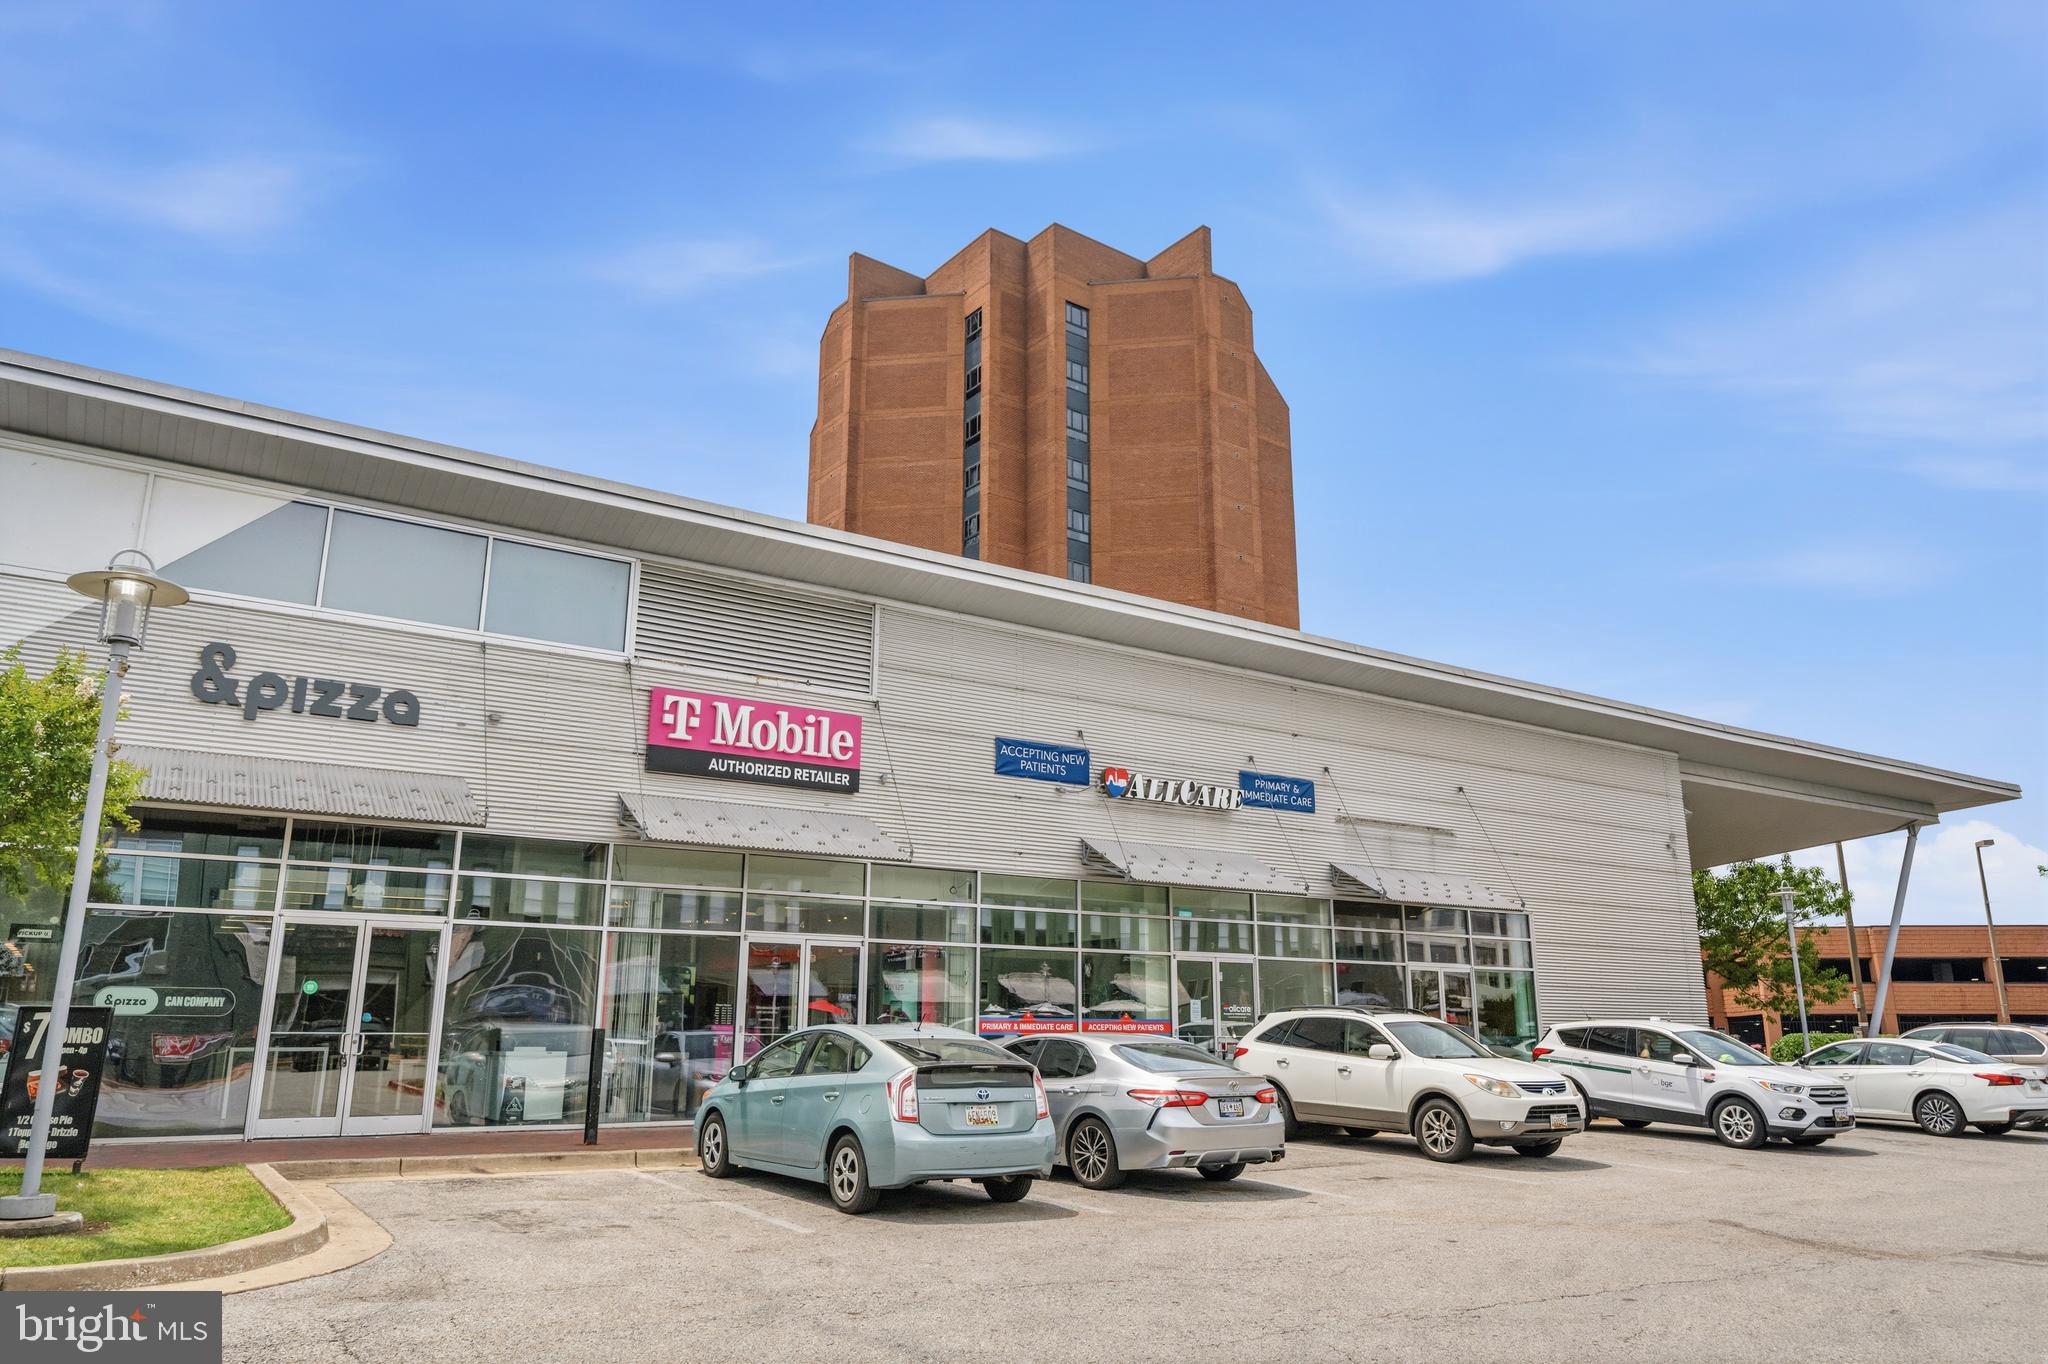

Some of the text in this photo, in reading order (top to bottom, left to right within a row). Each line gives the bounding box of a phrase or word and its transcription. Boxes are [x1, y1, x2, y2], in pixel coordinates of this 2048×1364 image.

[191, 641, 420, 727] &pizza
[709, 701, 854, 762] Mobile
[1000, 745, 1085, 766] ACCEPTING NEW
[708, 758, 850, 786] AUTHORIZED RETAILER
[1020, 759, 1067, 776] PATIENTS
[1255, 779, 1300, 793] PRIMARY &
[1244, 790, 1313, 807] MMEDIATE CARE
[164, 996, 226, 1008] CAN COMPANY
[981, 1023, 1074, 1031] PRIMARY & IMMEDIATE CARE
[1088, 1023, 1123, 1031] ACCEPTING
[1137, 1024, 1165, 1032] PATIENTS
[1660, 1079, 1673, 1088] bge
